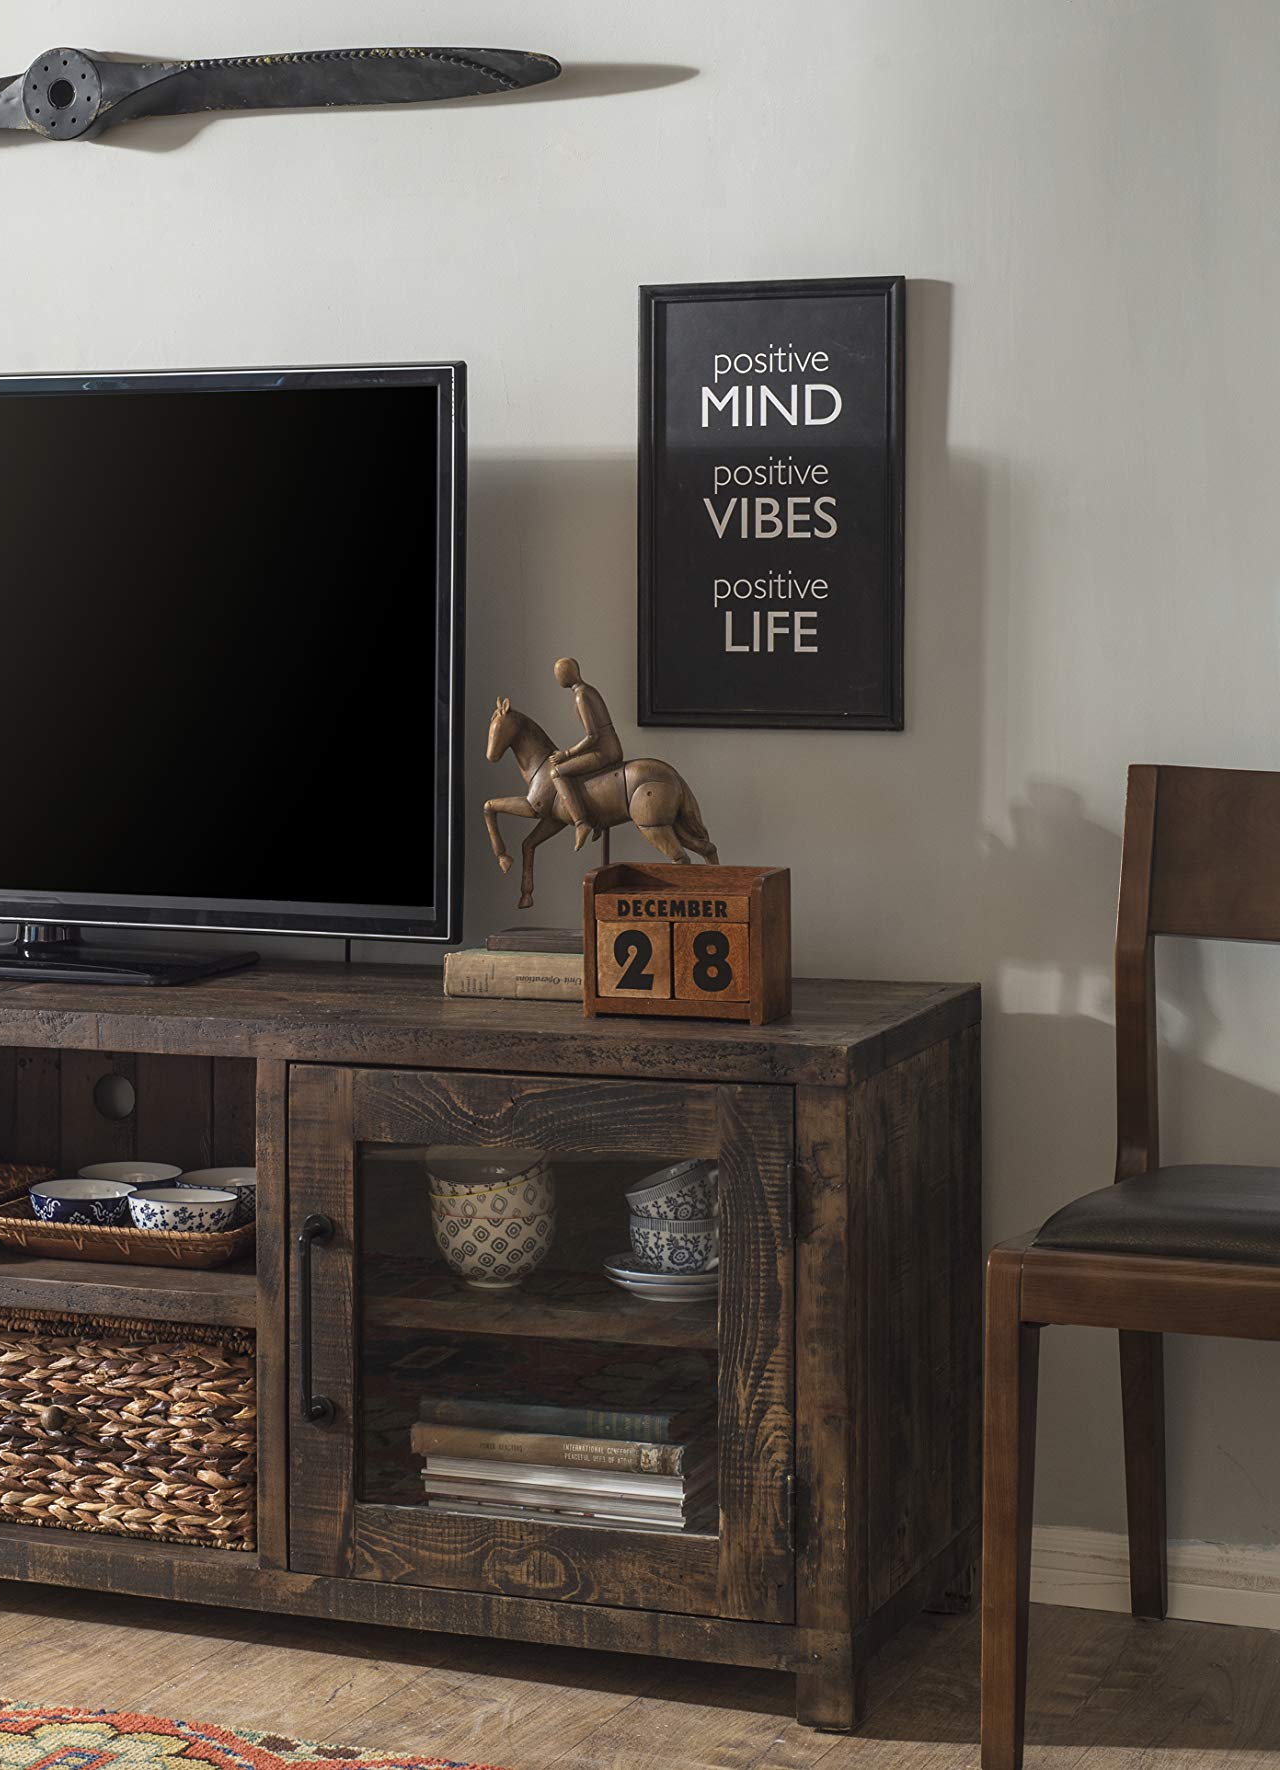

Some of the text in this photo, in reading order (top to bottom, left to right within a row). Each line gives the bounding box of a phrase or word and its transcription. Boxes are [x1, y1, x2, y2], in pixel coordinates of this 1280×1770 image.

[714, 343, 829, 384] positive
[701, 383, 842, 428] MIND
[714, 456, 829, 495] positive
[704, 495, 838, 540] VIBES
[714, 570, 829, 608] positive
[725, 611, 819, 654] LIFE
[616, 899, 729, 919] DECEMBER
[515, 975, 561, 985] Operations
[613, 928, 734, 993] 2 8
